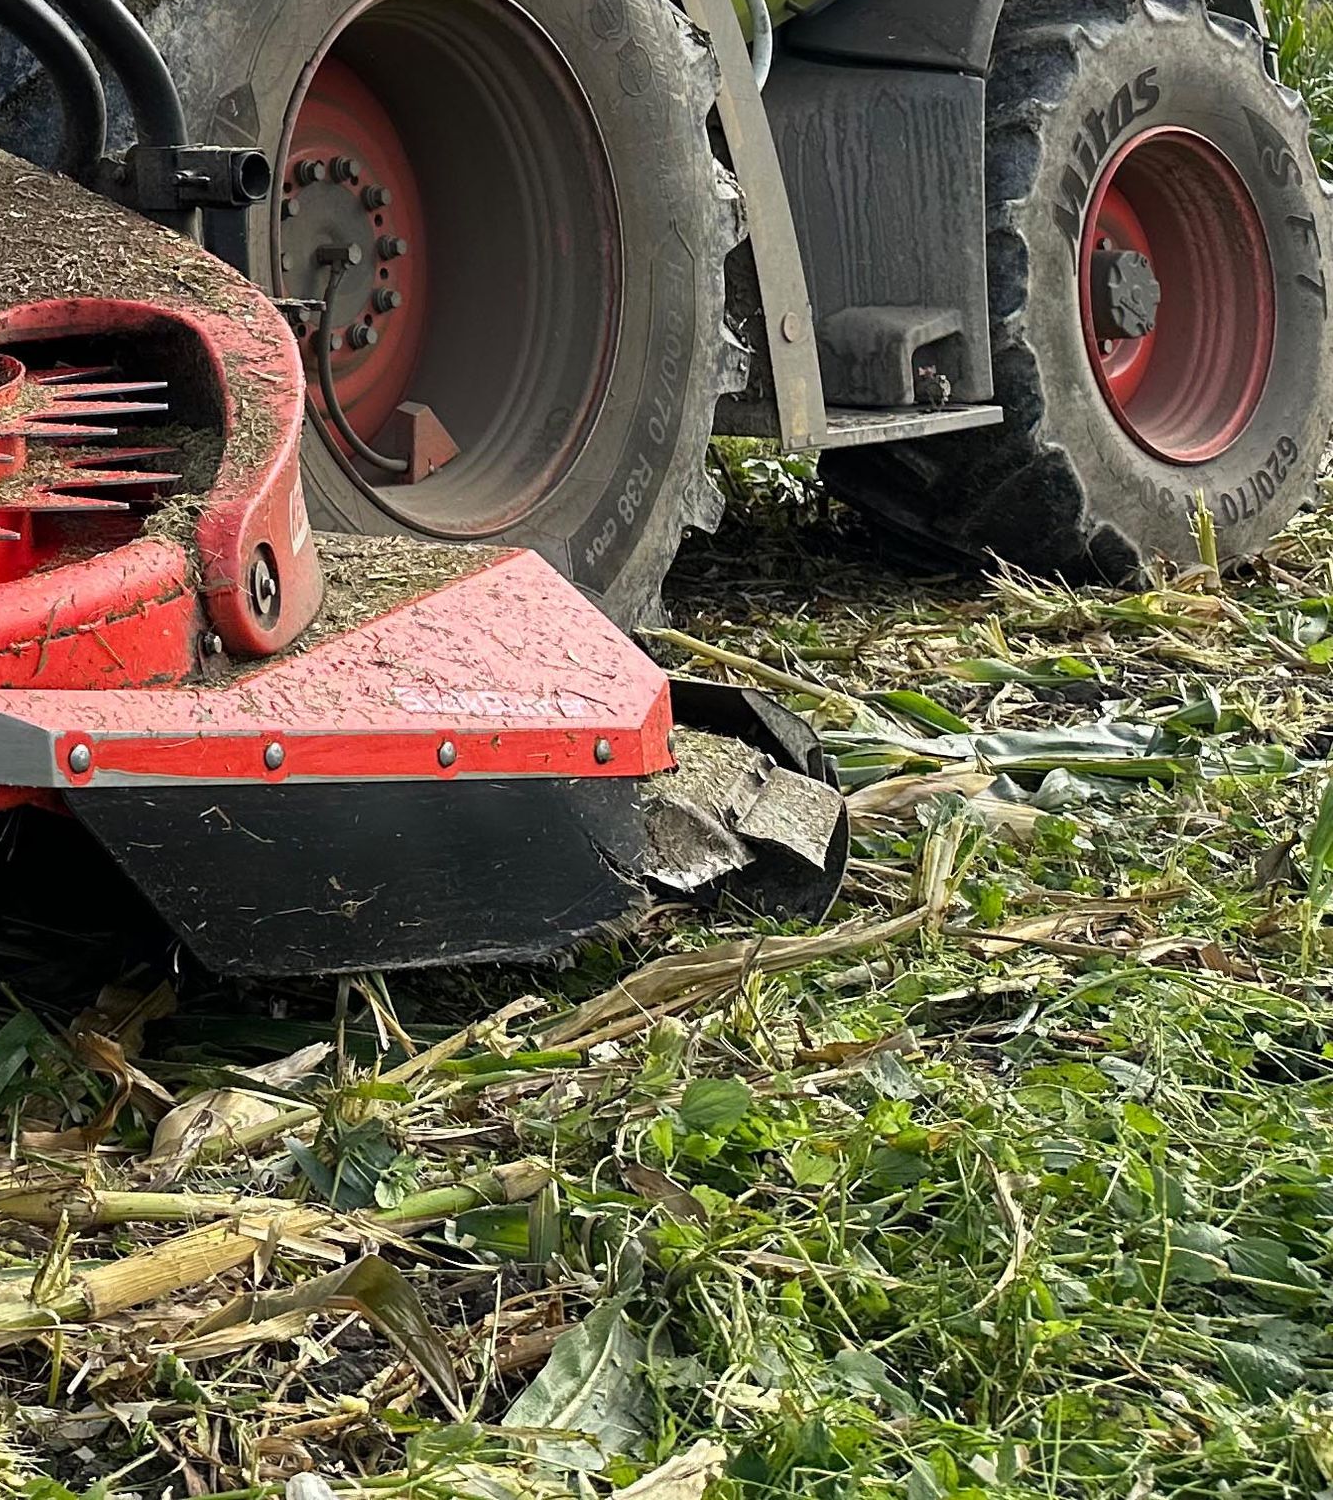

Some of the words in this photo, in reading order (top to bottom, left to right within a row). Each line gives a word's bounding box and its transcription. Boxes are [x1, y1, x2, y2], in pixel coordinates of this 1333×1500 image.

[1052, 66, 1160, 277] Mitas
[647, 309, 686, 445] 800/70
[617, 452, 655, 527] R38
[1219, 435, 1299, 527] 620/70
